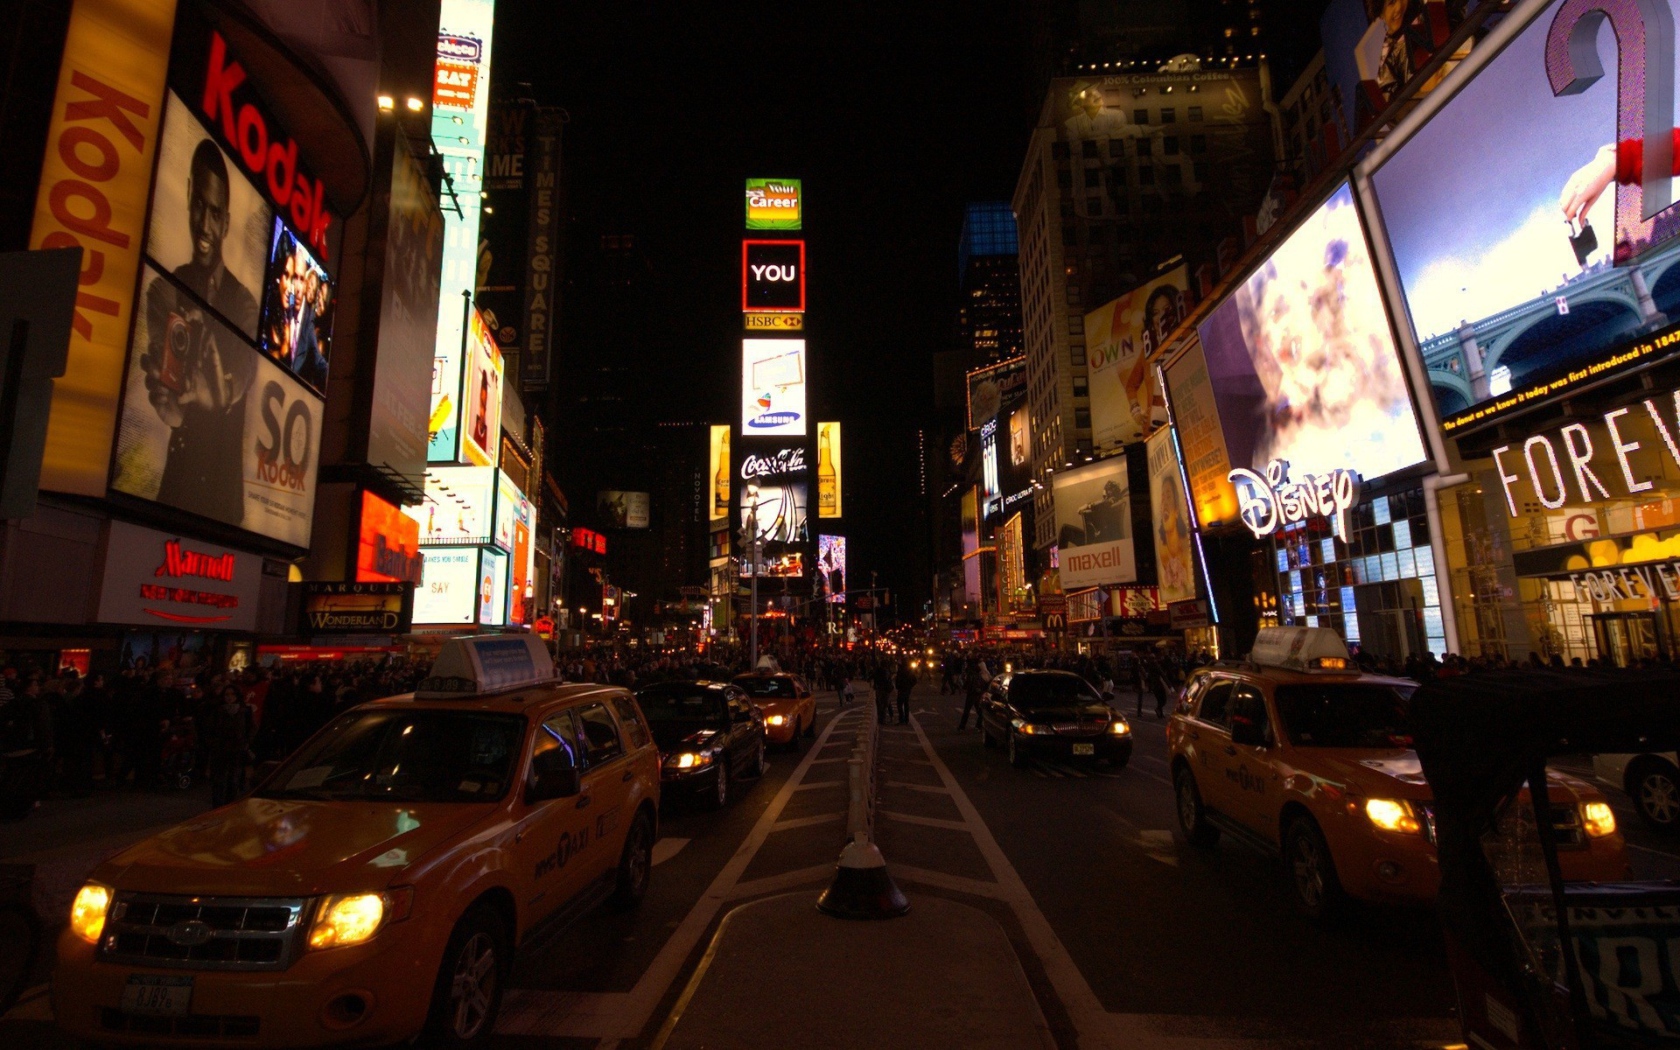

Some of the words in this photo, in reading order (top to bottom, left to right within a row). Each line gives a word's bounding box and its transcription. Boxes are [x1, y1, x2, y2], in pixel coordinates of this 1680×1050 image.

[203, 30, 332, 262] Kodak
[484, 153, 525, 178] AME
[536, 137, 555, 225] TIMES
[768, 183, 795, 194] Your
[749, 196, 798, 208] Career
[751, 264, 796, 282] YOU
[528, 235, 552, 353] SQUARE
[746, 316, 781, 326] HSBC
[1091, 336, 1135, 368] OWN
[1443, 422, 1456, 431] The
[1456, 412, 1475, 426] donut
[1475, 409, 1484, 419] as
[1484, 405, 1496, 416] we
[1495, 396, 1517, 412] know
[1518, 393, 1525, 402] it
[1525, 382, 1549, 401] today
[1549, 377, 1568, 390] was
[1568, 369, 1588, 385] first
[1588, 347, 1640, 374] introduced
[1641, 343, 1653, 354] in
[1654, 330, 1680, 350] 1847
[754, 416, 794, 424] SAMSUNG
[154, 539, 235, 582] Marriott
[1068, 546, 1121, 573] maxell
[141, 584, 168, 600] NEW
[309, 584, 404, 593] MARQUIS
[431, 582, 449, 594] SAY
[309, 611, 400, 630] WONDERLAND
